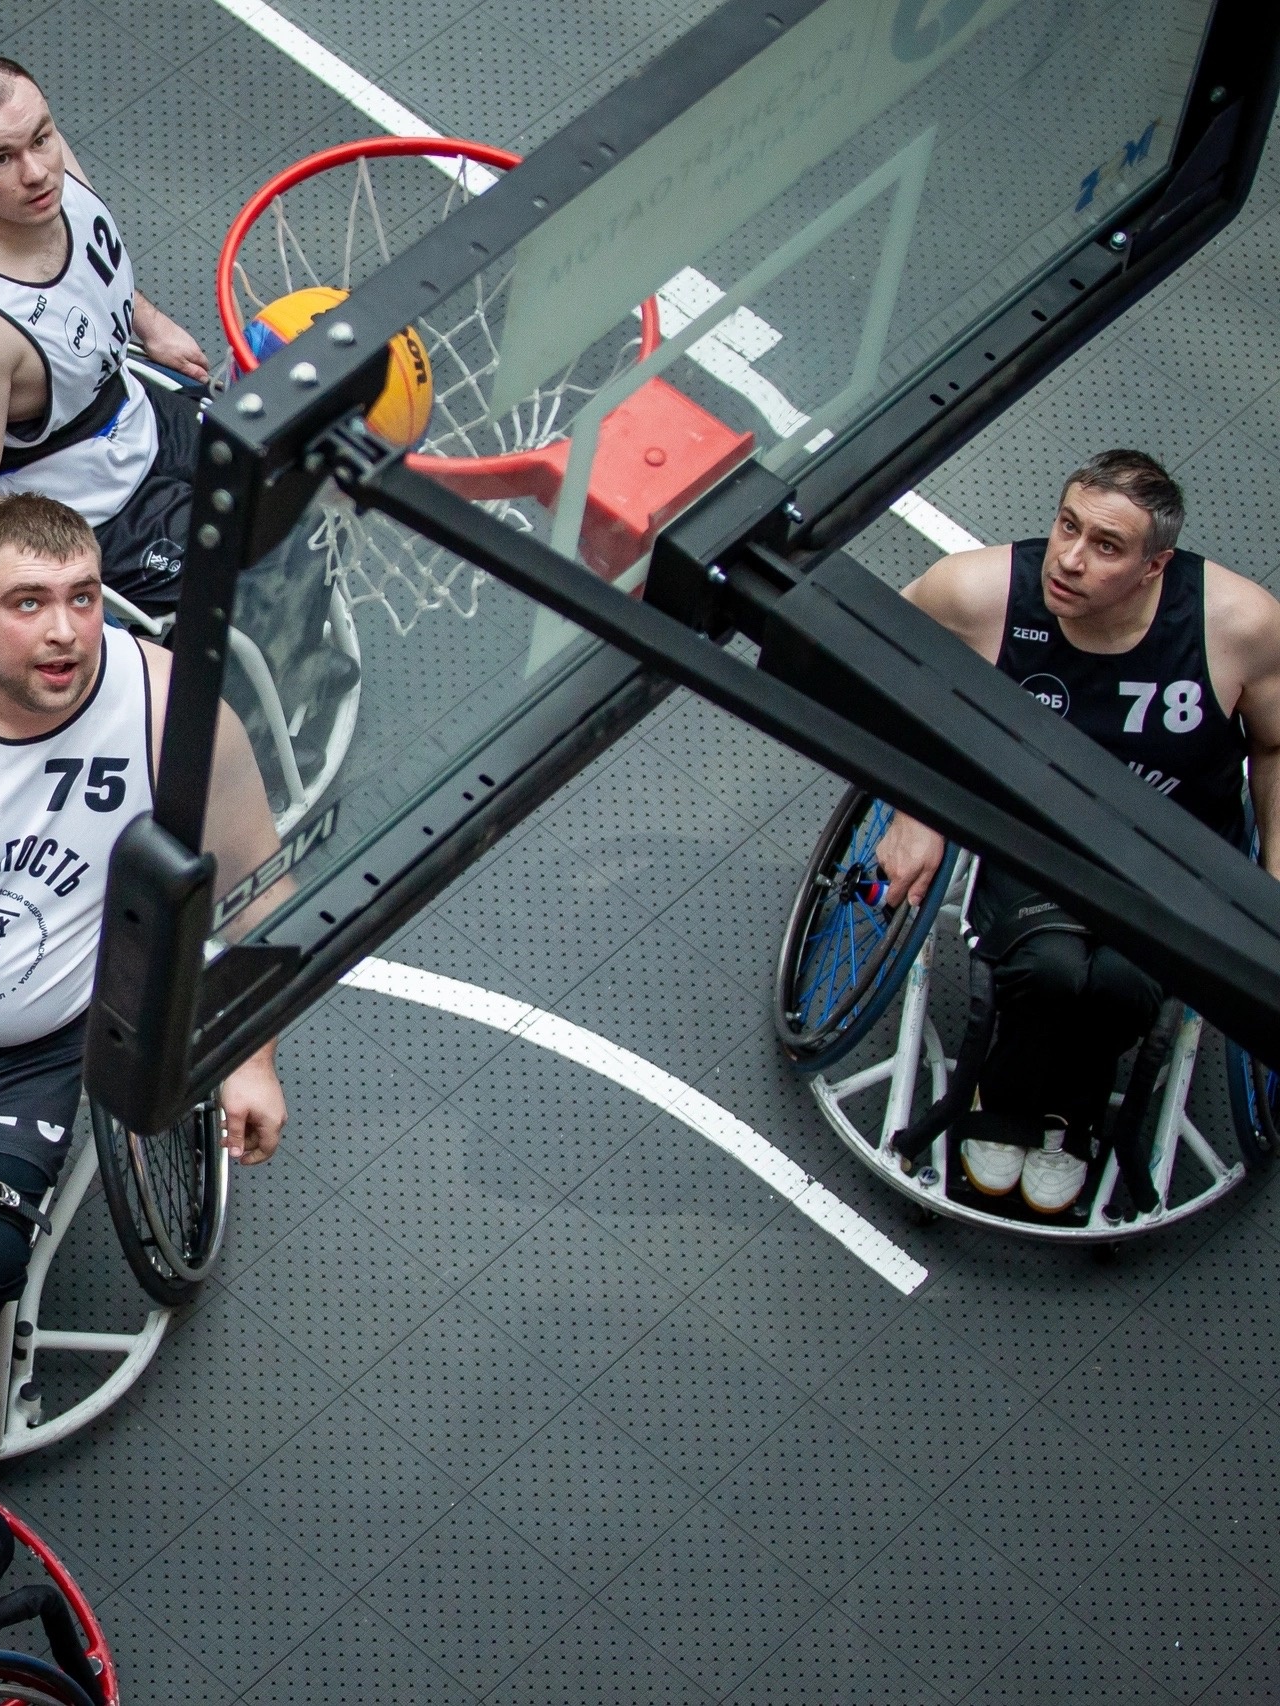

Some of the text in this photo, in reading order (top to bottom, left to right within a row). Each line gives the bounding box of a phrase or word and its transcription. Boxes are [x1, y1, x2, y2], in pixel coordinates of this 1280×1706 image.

[86, 215, 122, 288] 12
[28, 294, 47, 326] ZEDO
[73, 313, 89, 350] РФБ
[1013, 626, 1049, 642] ZEDO
[1027, 691, 1063, 709] ФБ
[1119, 680, 1203, 733] 78
[44, 757, 130, 813] 75
